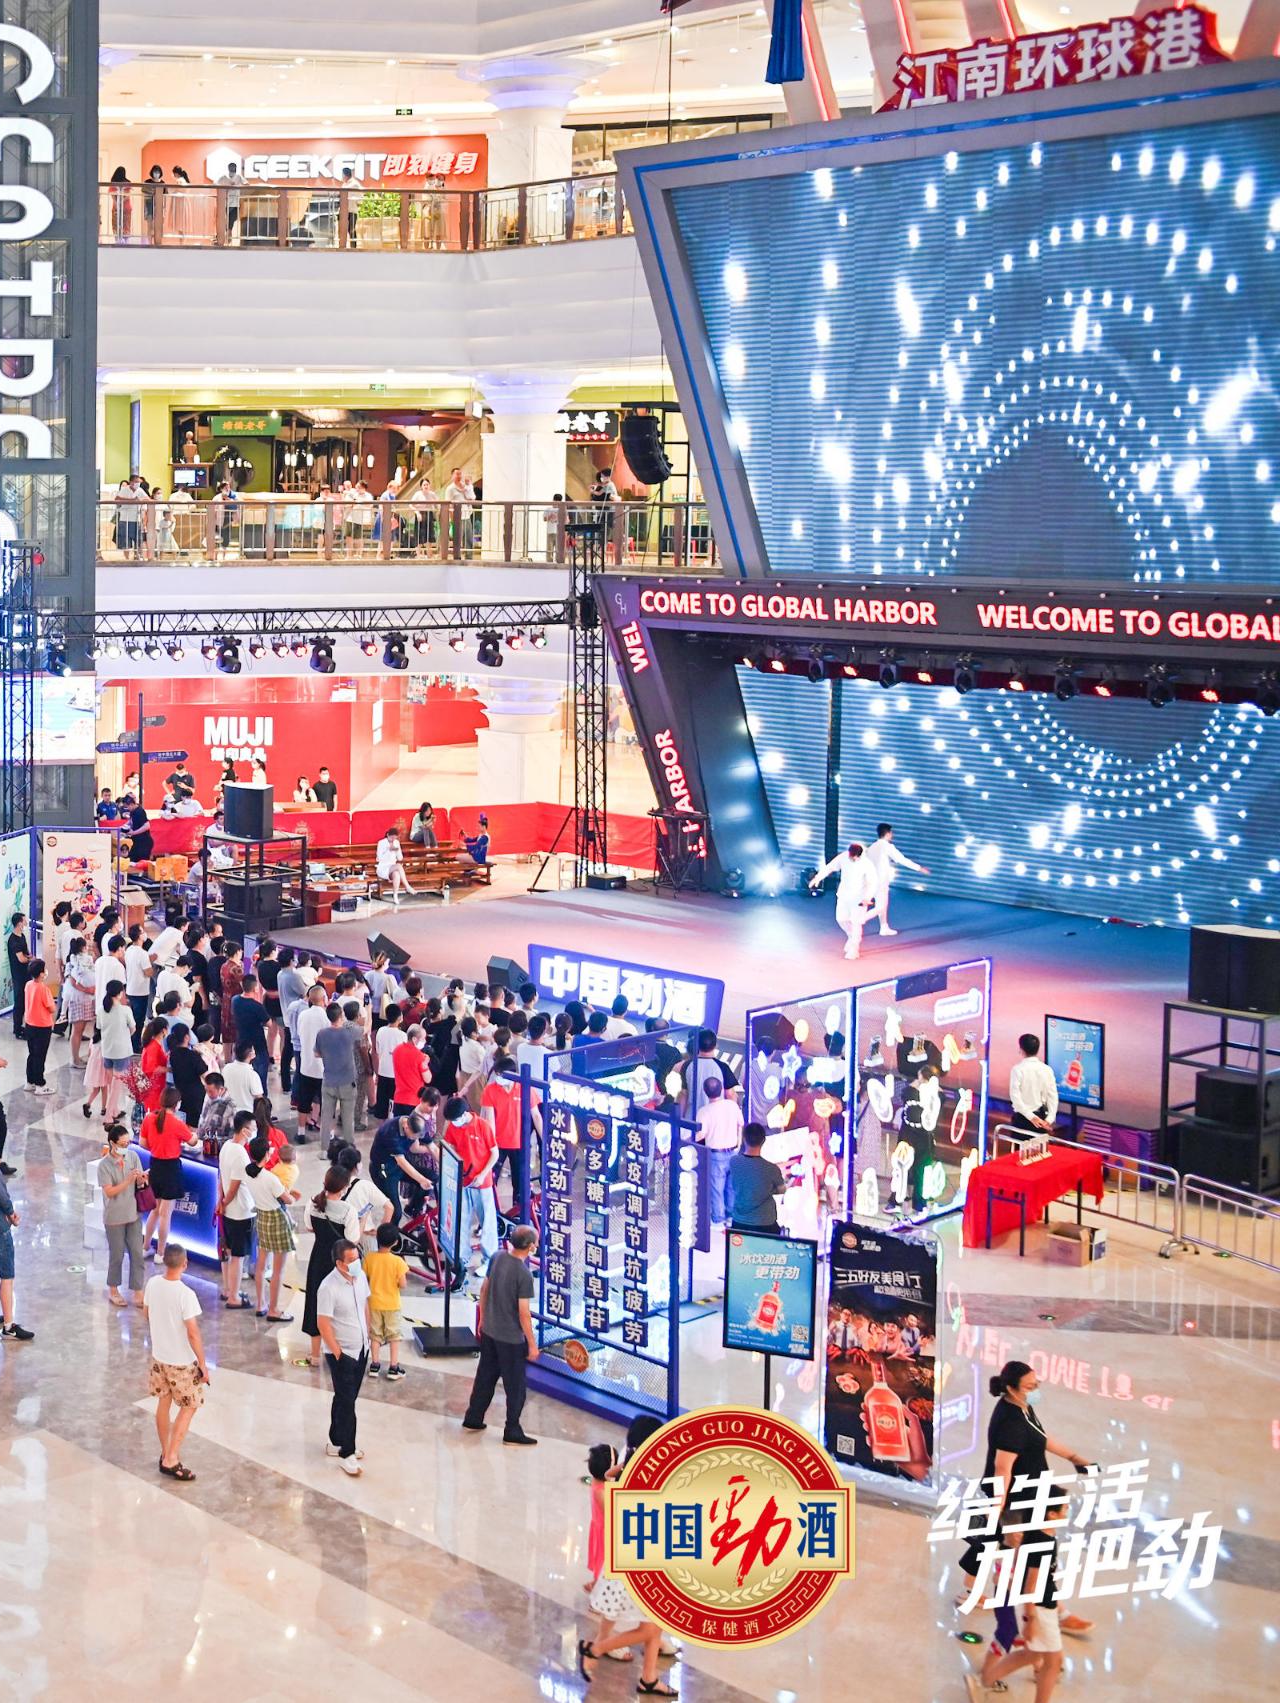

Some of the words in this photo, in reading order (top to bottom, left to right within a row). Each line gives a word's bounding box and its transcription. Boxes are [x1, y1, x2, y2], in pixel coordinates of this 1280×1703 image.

[894, 9, 1202, 110] 江南环球港
[382, 152, 478, 176] 即刻健身
[640, 590, 702, 614] COME
[706, 593, 736, 616] TO
[741, 595, 829, 620] GLOBAL
[834, 598, 938, 625] HARBOR
[977, 604, 1114, 633] WELCOME
[1120, 609, 1161, 635] TO
[621, 620, 651, 674] WEL
[204, 717, 273, 746] MUJI
[540, 955, 707, 1026] 中国劲酒
[549, 1108, 567, 1315] 冰饮劲酒更带劲
[624, 1130, 643, 1343] 免疫调节抗疲劳
[753, 1266, 800, 1279] 更带劲
